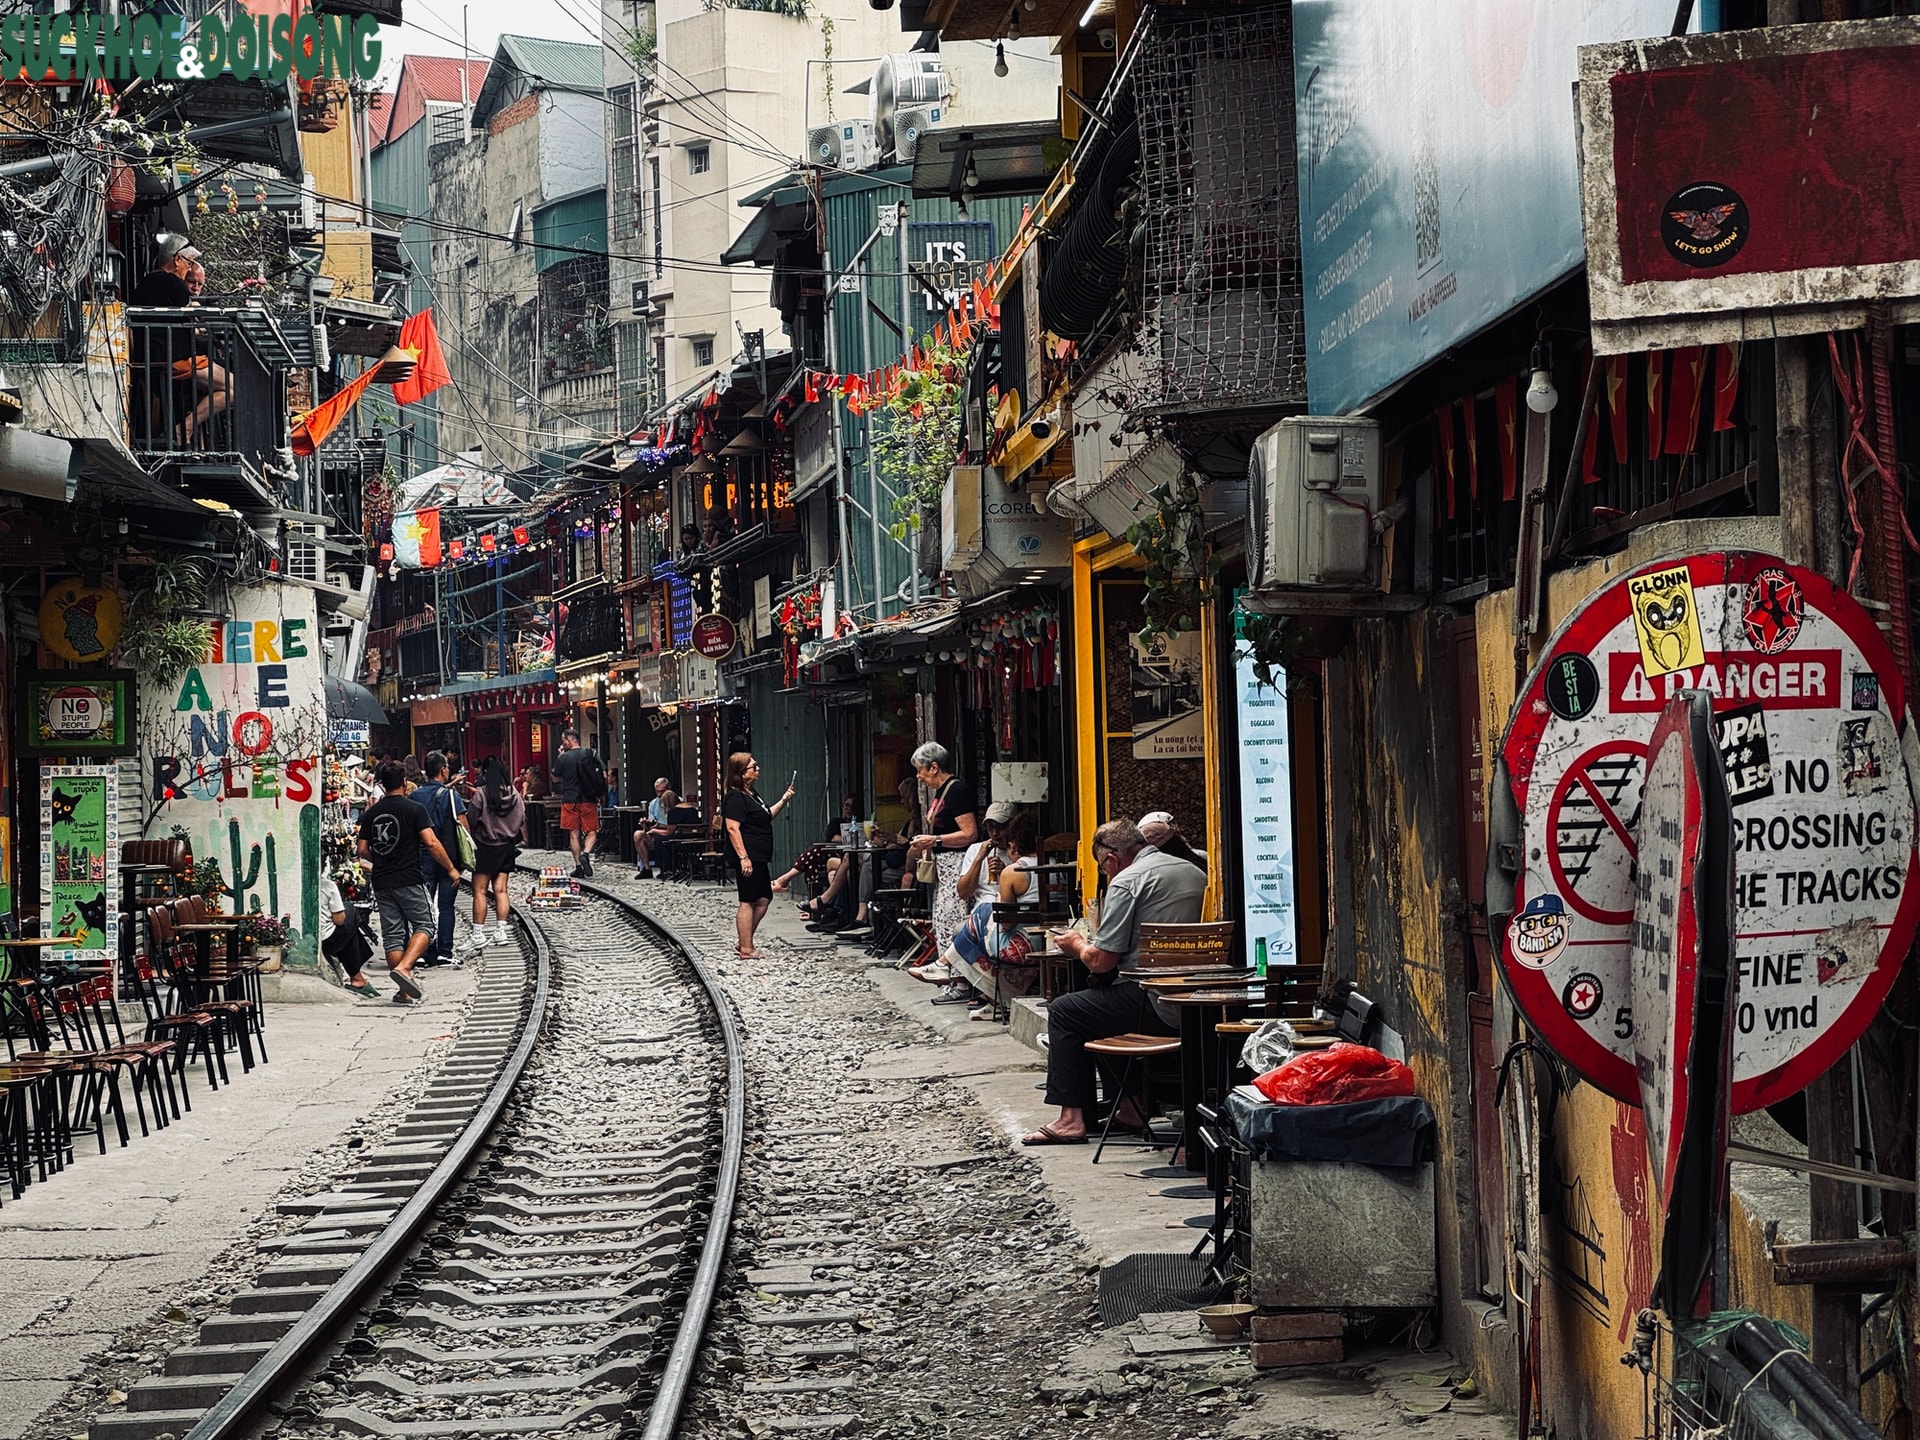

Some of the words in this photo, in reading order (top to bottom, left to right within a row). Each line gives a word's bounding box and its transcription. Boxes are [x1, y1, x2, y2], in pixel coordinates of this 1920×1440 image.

[925, 241, 966, 262] IT'S
[1674, 239, 1697, 254] LET'S
[1713, 231, 1738, 253] SHOW
[1631, 570, 1688, 596] GLÖNN
[176, 664, 290, 712] ARE
[1664, 662, 1826, 700] DANGER
[190, 710, 274, 757] NO
[331, 721, 368, 731] EXCHANGE
[153, 755, 313, 803] RULES
[1259, 758, 1269, 766] TEA
[1784, 757, 1830, 794] NO
[1260, 883, 1278, 891] FOODS
[1775, 865, 1902, 907] TRACKS
[1519, 925, 1563, 952] BANDISM
[1736, 953, 1803, 988] FINE
[1764, 995, 1818, 1032] vnd
